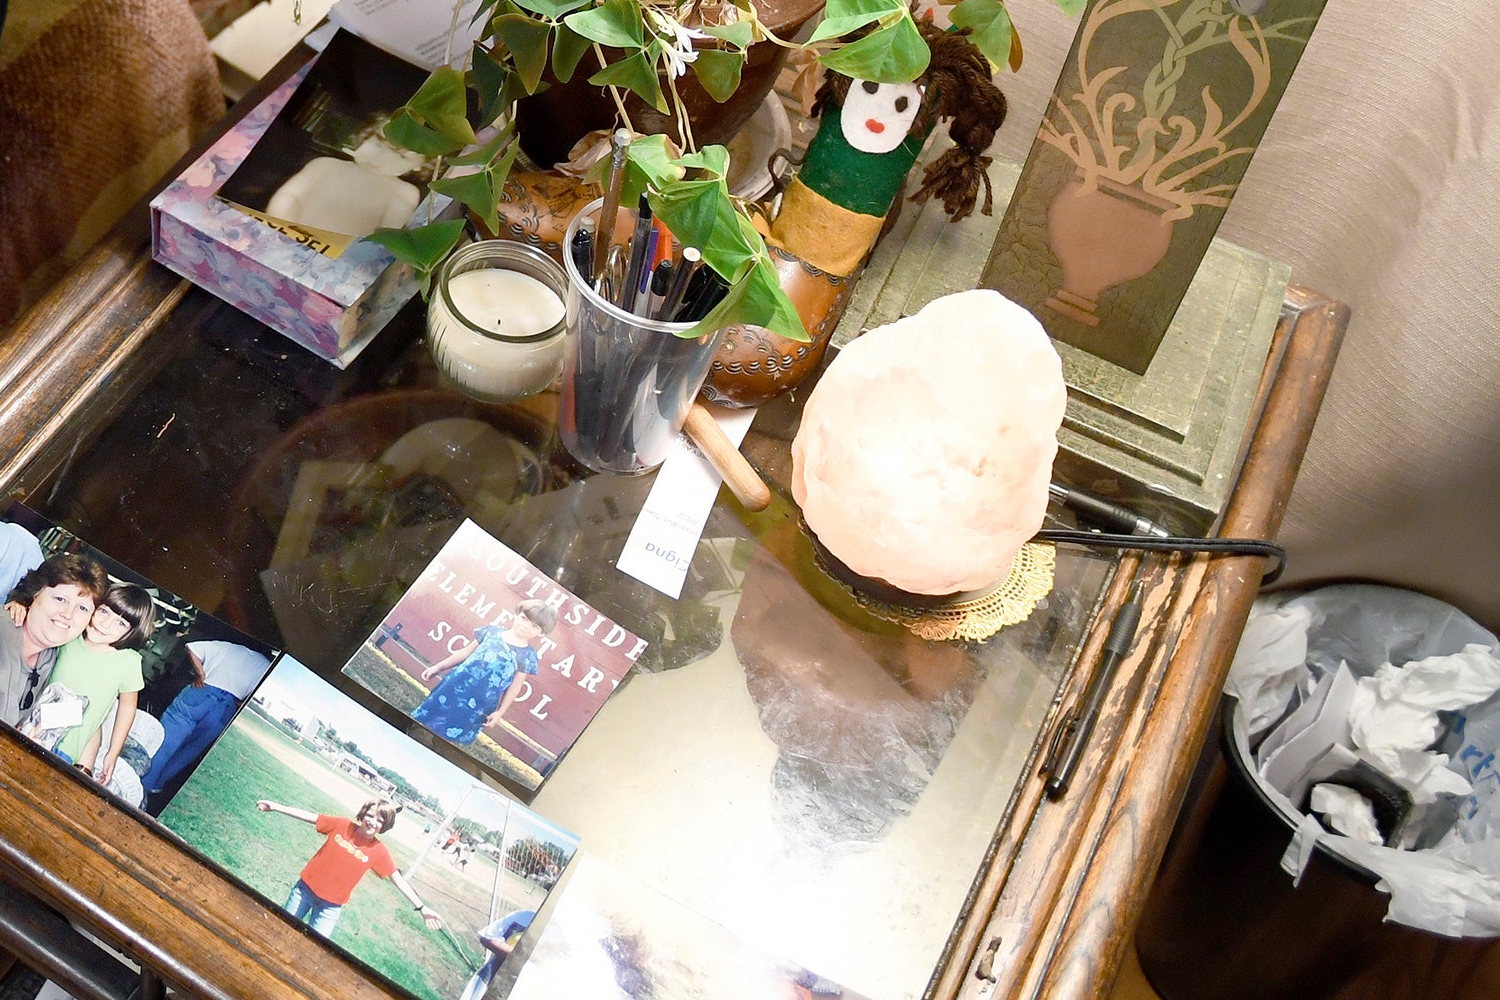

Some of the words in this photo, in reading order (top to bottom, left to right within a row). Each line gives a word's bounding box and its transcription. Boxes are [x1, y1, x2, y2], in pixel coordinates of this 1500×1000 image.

[467, 539, 649, 662] SOUTHSIDE
[644, 541, 691, 572] Cigna
[425, 561, 619, 694] ELEMETAR
[427, 621, 554, 721] SCOL
